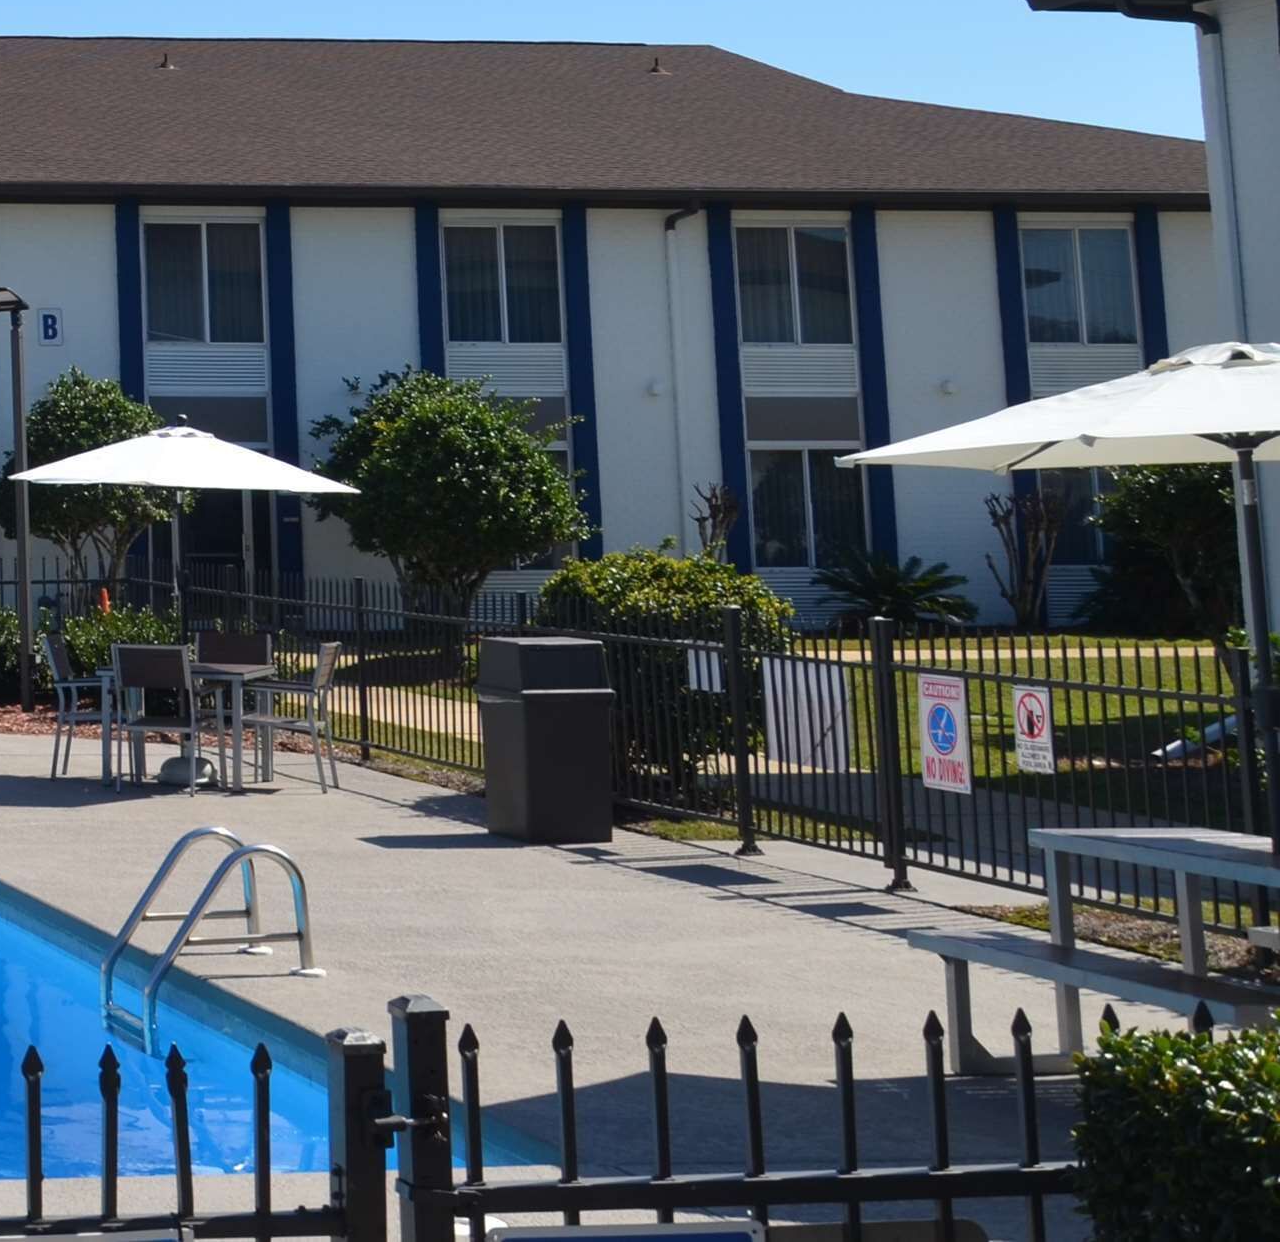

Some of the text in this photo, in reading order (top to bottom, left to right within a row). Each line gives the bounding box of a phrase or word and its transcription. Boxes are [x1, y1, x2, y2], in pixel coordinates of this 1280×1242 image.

[42, 314, 58, 340] B
[925, 756, 966, 784] NO DIVING!
